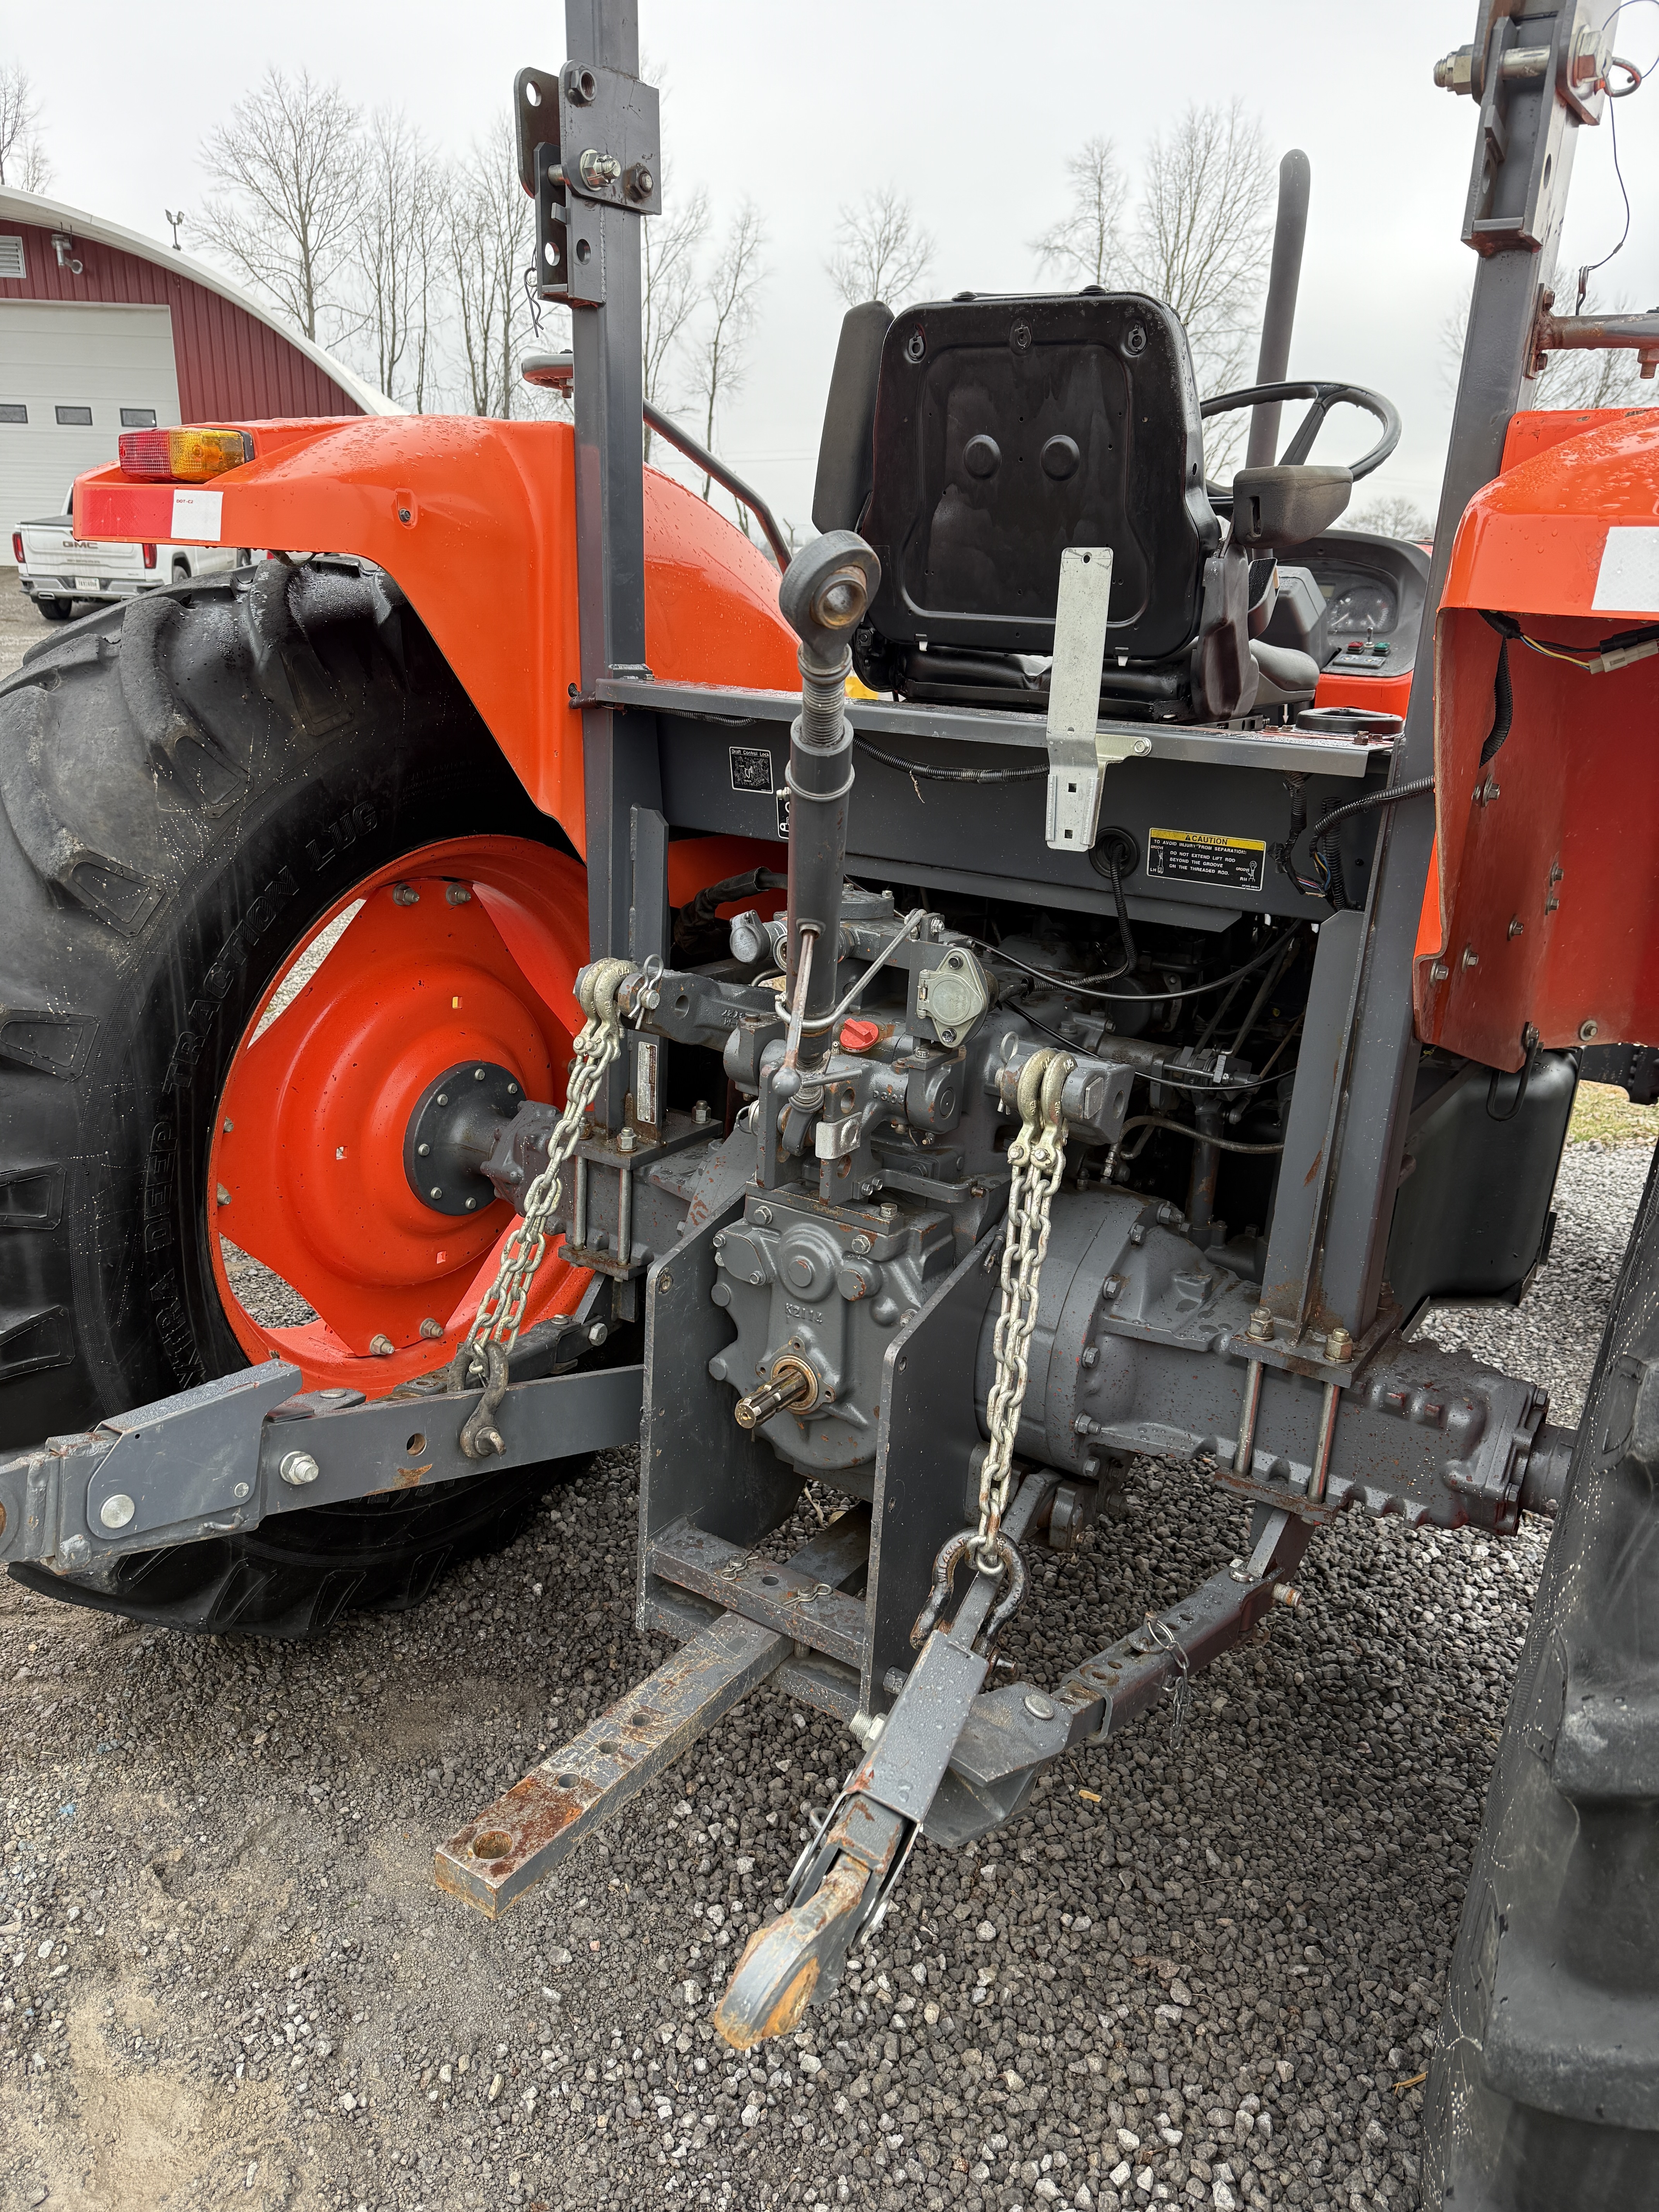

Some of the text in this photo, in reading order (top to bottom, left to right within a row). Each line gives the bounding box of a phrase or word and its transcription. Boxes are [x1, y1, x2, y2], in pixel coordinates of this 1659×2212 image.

[63, 541, 99, 549] GMC
[306, 800, 379, 872] LUG
[1192, 835, 1228, 845] CAUTION
[161, 865, 300, 1094] TRACTION
[145, 1121, 179, 1253] DEEP
